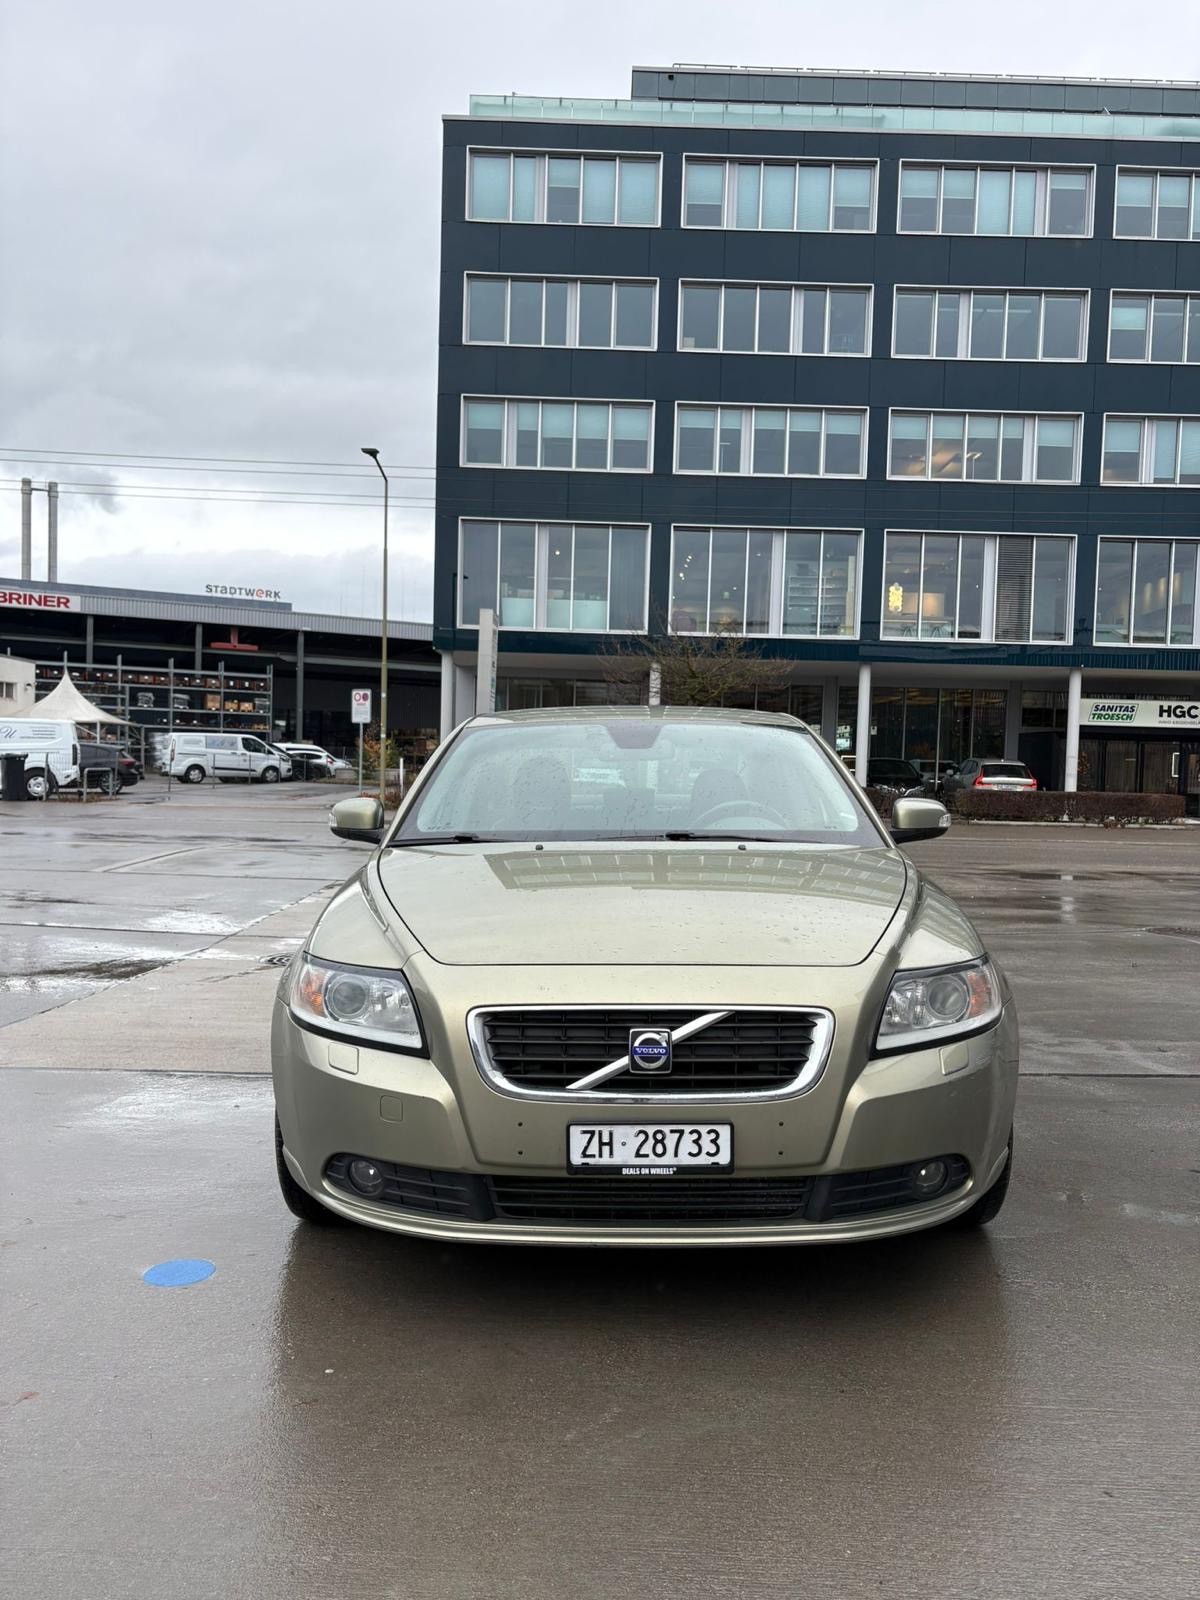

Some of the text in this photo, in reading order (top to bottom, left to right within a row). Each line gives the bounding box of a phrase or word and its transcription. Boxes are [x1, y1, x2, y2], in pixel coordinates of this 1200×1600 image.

[1093, 704, 1136, 713] SANITAS
[1158, 704, 1199, 719] HGC
[1091, 713, 1134, 721] TROESCH
[580, 1129, 720, 1158] ZH 28733
[622, 1167, 640, 1175] DEALS
[640, 1167, 650, 1175] ON
